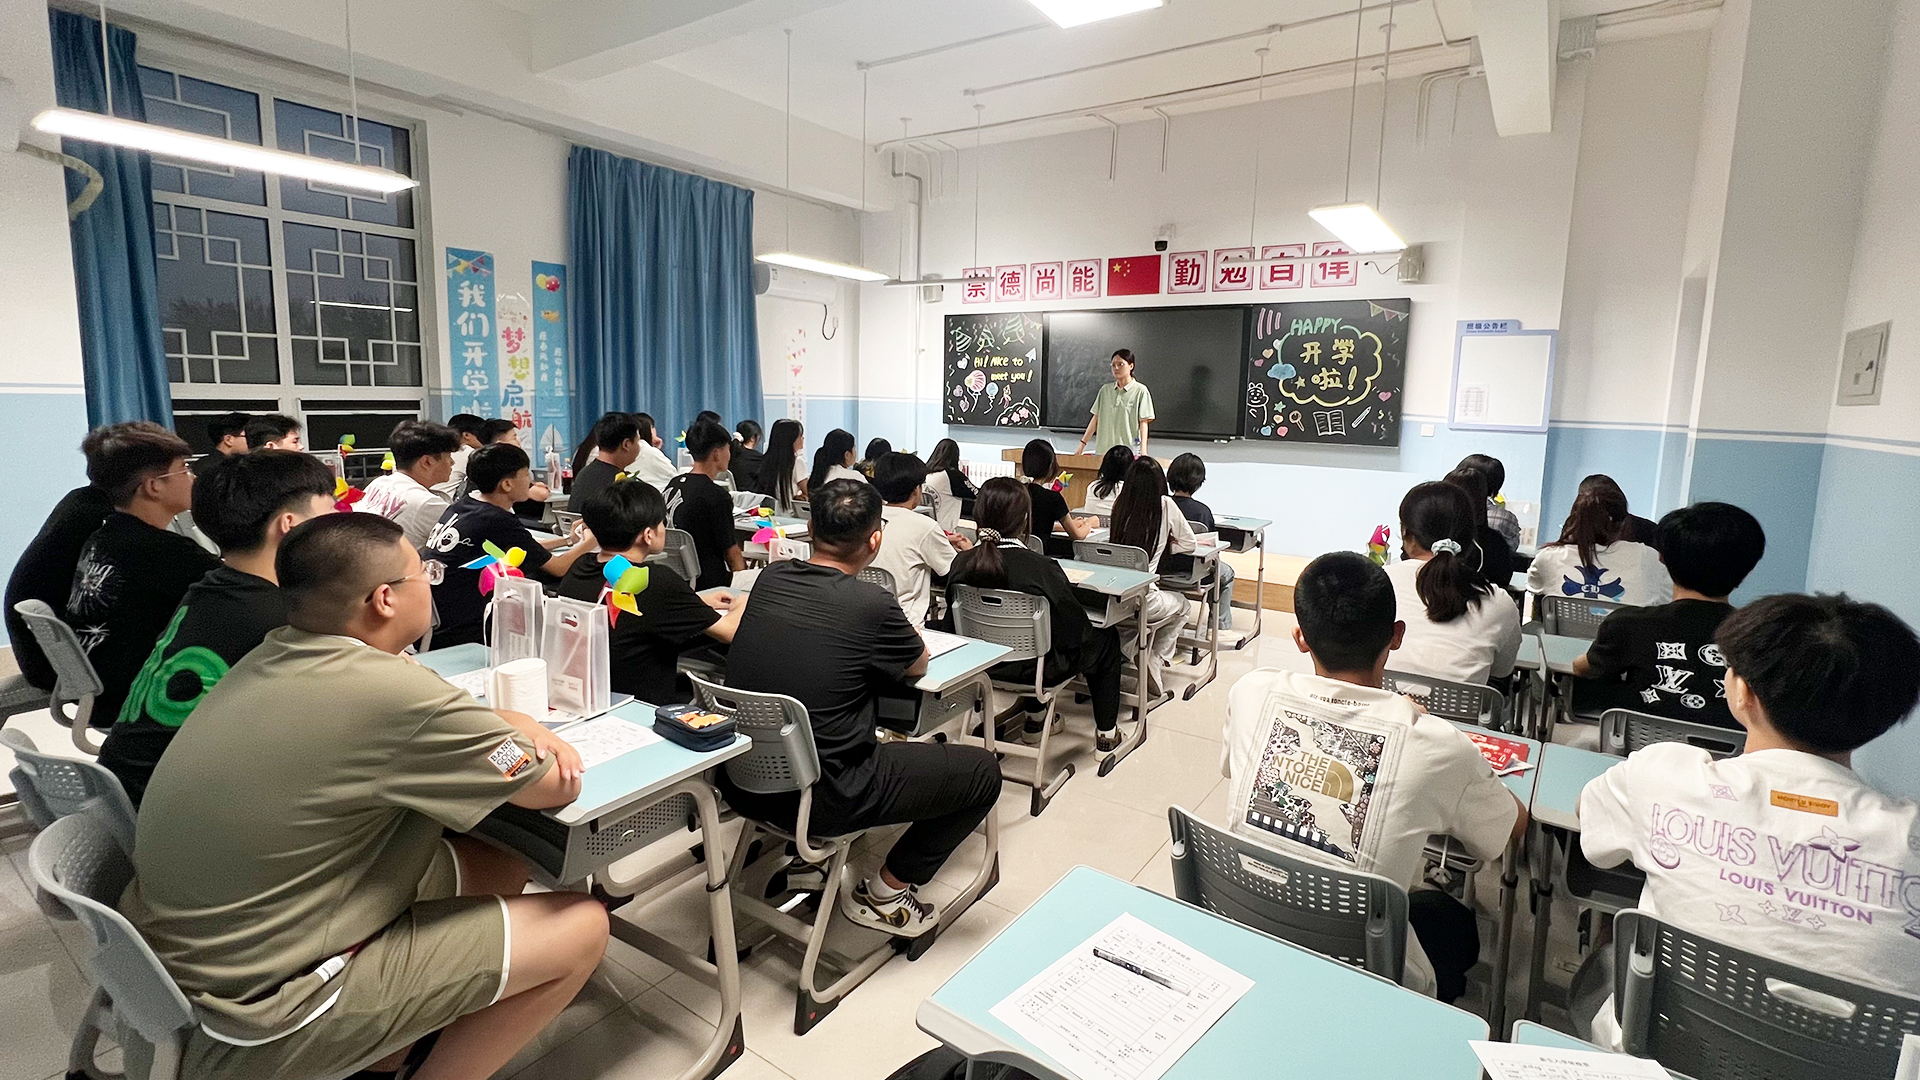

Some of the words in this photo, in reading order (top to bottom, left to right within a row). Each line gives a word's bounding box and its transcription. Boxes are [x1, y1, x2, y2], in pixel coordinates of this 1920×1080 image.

[968, 266, 1095, 298] 崇德尚能
[1174, 248, 1350, 287] 勤勉自律
[1290, 317, 1342, 336] HAPPY
[1012, 357, 1024, 367] to
[1300, 338, 1355, 366] 开学
[501, 326, 532, 430] 梦想启航
[490, 740, 513, 762] BAND
[496, 745, 516, 766] GOOD
[1301, 750, 1330, 769] THE
[1272, 755, 1326, 781] NTOER
[1284, 770, 1323, 793] NICE
[1651, 803, 1756, 867] LOUIS
[1720, 867, 1775, 896] LOUIS
[1784, 886, 1873, 925] VUITTON
